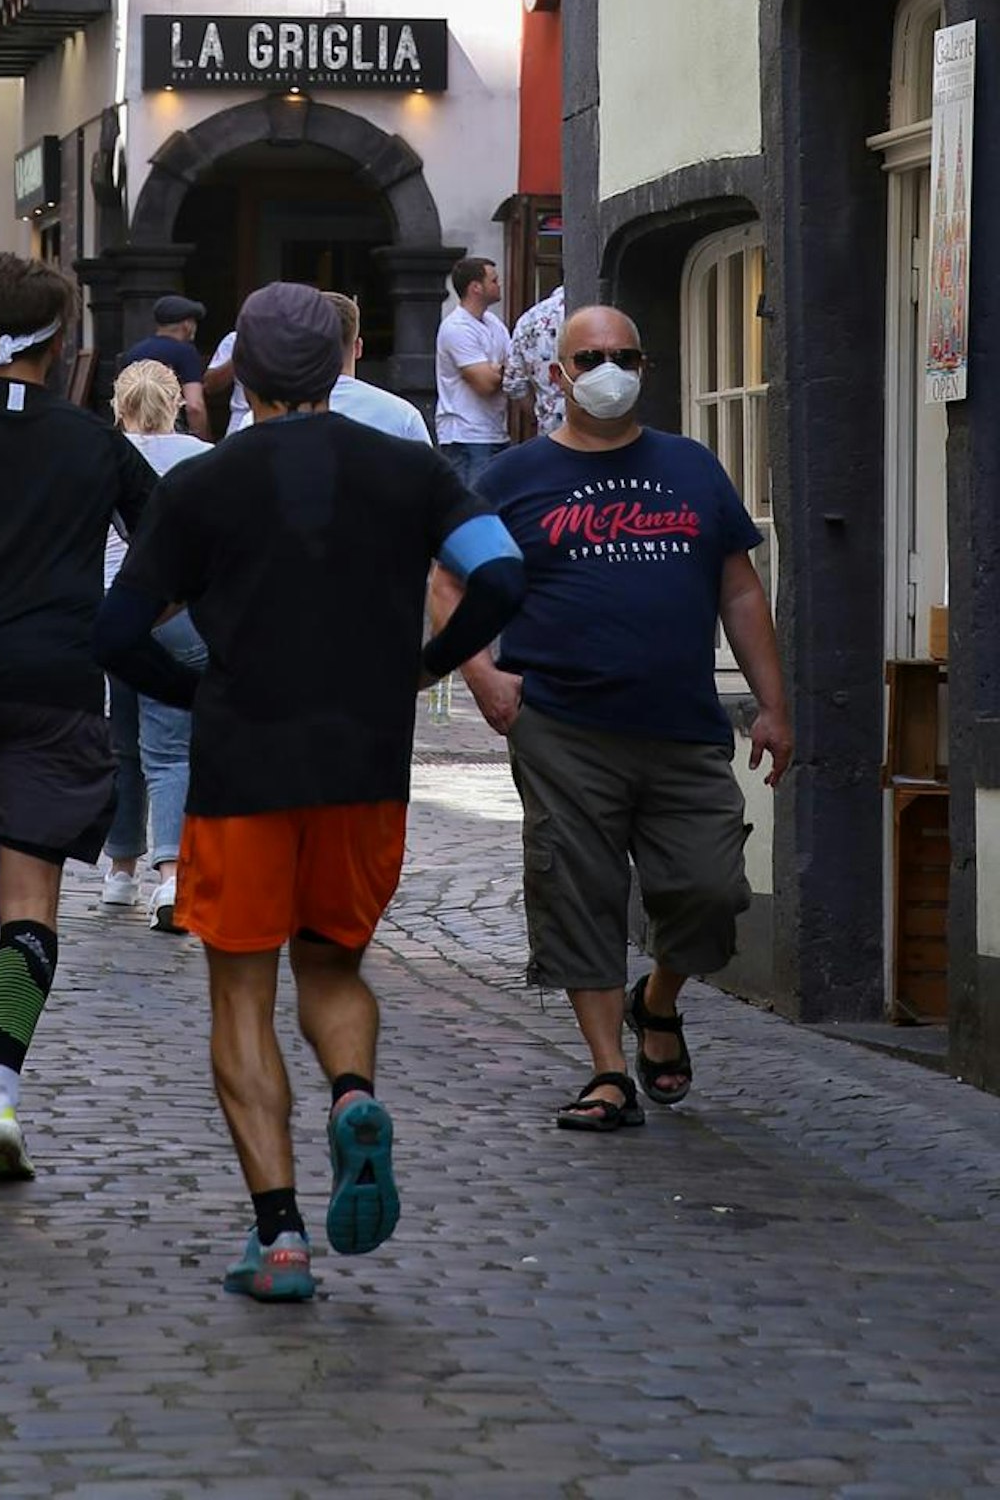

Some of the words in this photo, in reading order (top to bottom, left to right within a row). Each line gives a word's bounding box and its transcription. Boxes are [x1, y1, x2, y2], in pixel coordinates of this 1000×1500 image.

[171, 21, 225, 70] LA
[248, 21, 422, 72] GRIGLIA
[932, 374, 960, 401] OPEN
[540, 501, 701, 547] McKenzie
[568, 540, 692, 562] SPORTSWEAR
